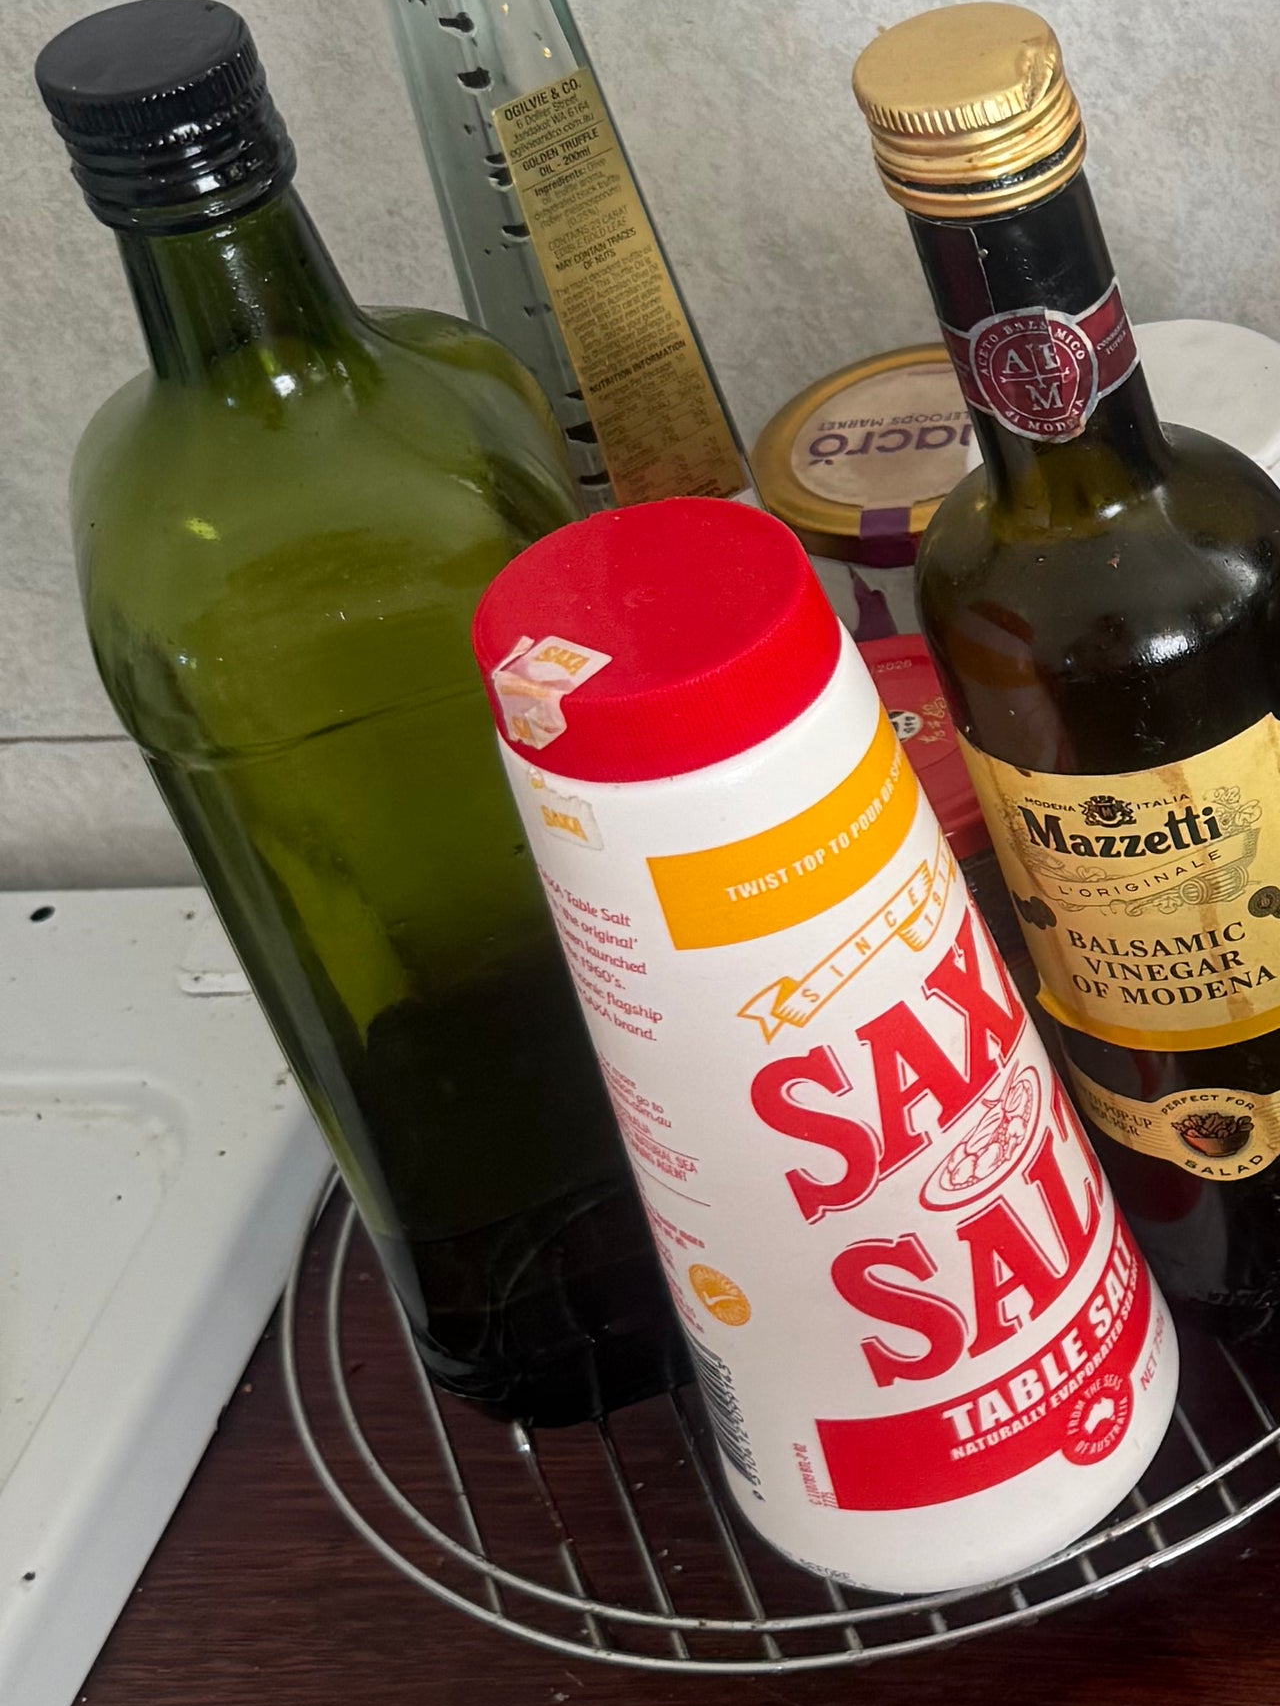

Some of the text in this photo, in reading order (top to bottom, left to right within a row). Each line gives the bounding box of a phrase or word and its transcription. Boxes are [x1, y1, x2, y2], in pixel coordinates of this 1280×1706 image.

[502, 90, 549, 121] OGILVIE
[548, 86, 560, 100] &
[560, 77, 582, 95] CO.
[552, 94, 578, 111] Street
[511, 119, 551, 144] Jandakot
[551, 111, 567, 125] WA
[521, 127, 599, 172] GOLDEN TRUFFLE
[538, 161, 555, 177] OIL
[562, 145, 591, 165] 200ml
[555, 227, 636, 272] MAY CONTAIN TRACES
[581, 248, 616, 271] OF NUTS
[587, 338, 687, 394] NUTRITION INFORMATION
[817, 416, 884, 432] MARKET
[1023, 792, 1191, 813] MODENA ITALIA
[725, 867, 789, 903] TWIST
[792, 847, 826, 877] TOP
[827, 831, 850, 855] TO
[849, 797, 883, 839] POUR
[1017, 805, 1224, 858] Mazzetti
[1057, 848, 1223, 899] L'ORIGINALE
[565, 891, 631, 927] Table Salt
[586, 941, 647, 975] launched
[801, 887, 919, 1003] SINCE
[1066, 921, 1248, 959] BALSAMIC
[580, 958, 626, 990] 1960's.
[1084, 949, 1246, 982] VINEGAR
[1071, 964, 1279, 1007] OF MODENA
[606, 992, 664, 1025] flagship
[614, 1015, 658, 1041] brand.
[1161, 1094, 1256, 1116] PERFECT FOR
[1184, 1154, 1264, 1178] SALAD
[942, 1224, 1132, 1441] TABLE SALT
[951, 1401, 1047, 1461] NATURALLY
[1050, 1321, 1125, 1410] EVAPORATED
[1067, 1373, 1124, 1436] FROM THE SEAS
[1088, 1395, 1129, 1456] AUSTRALIA
